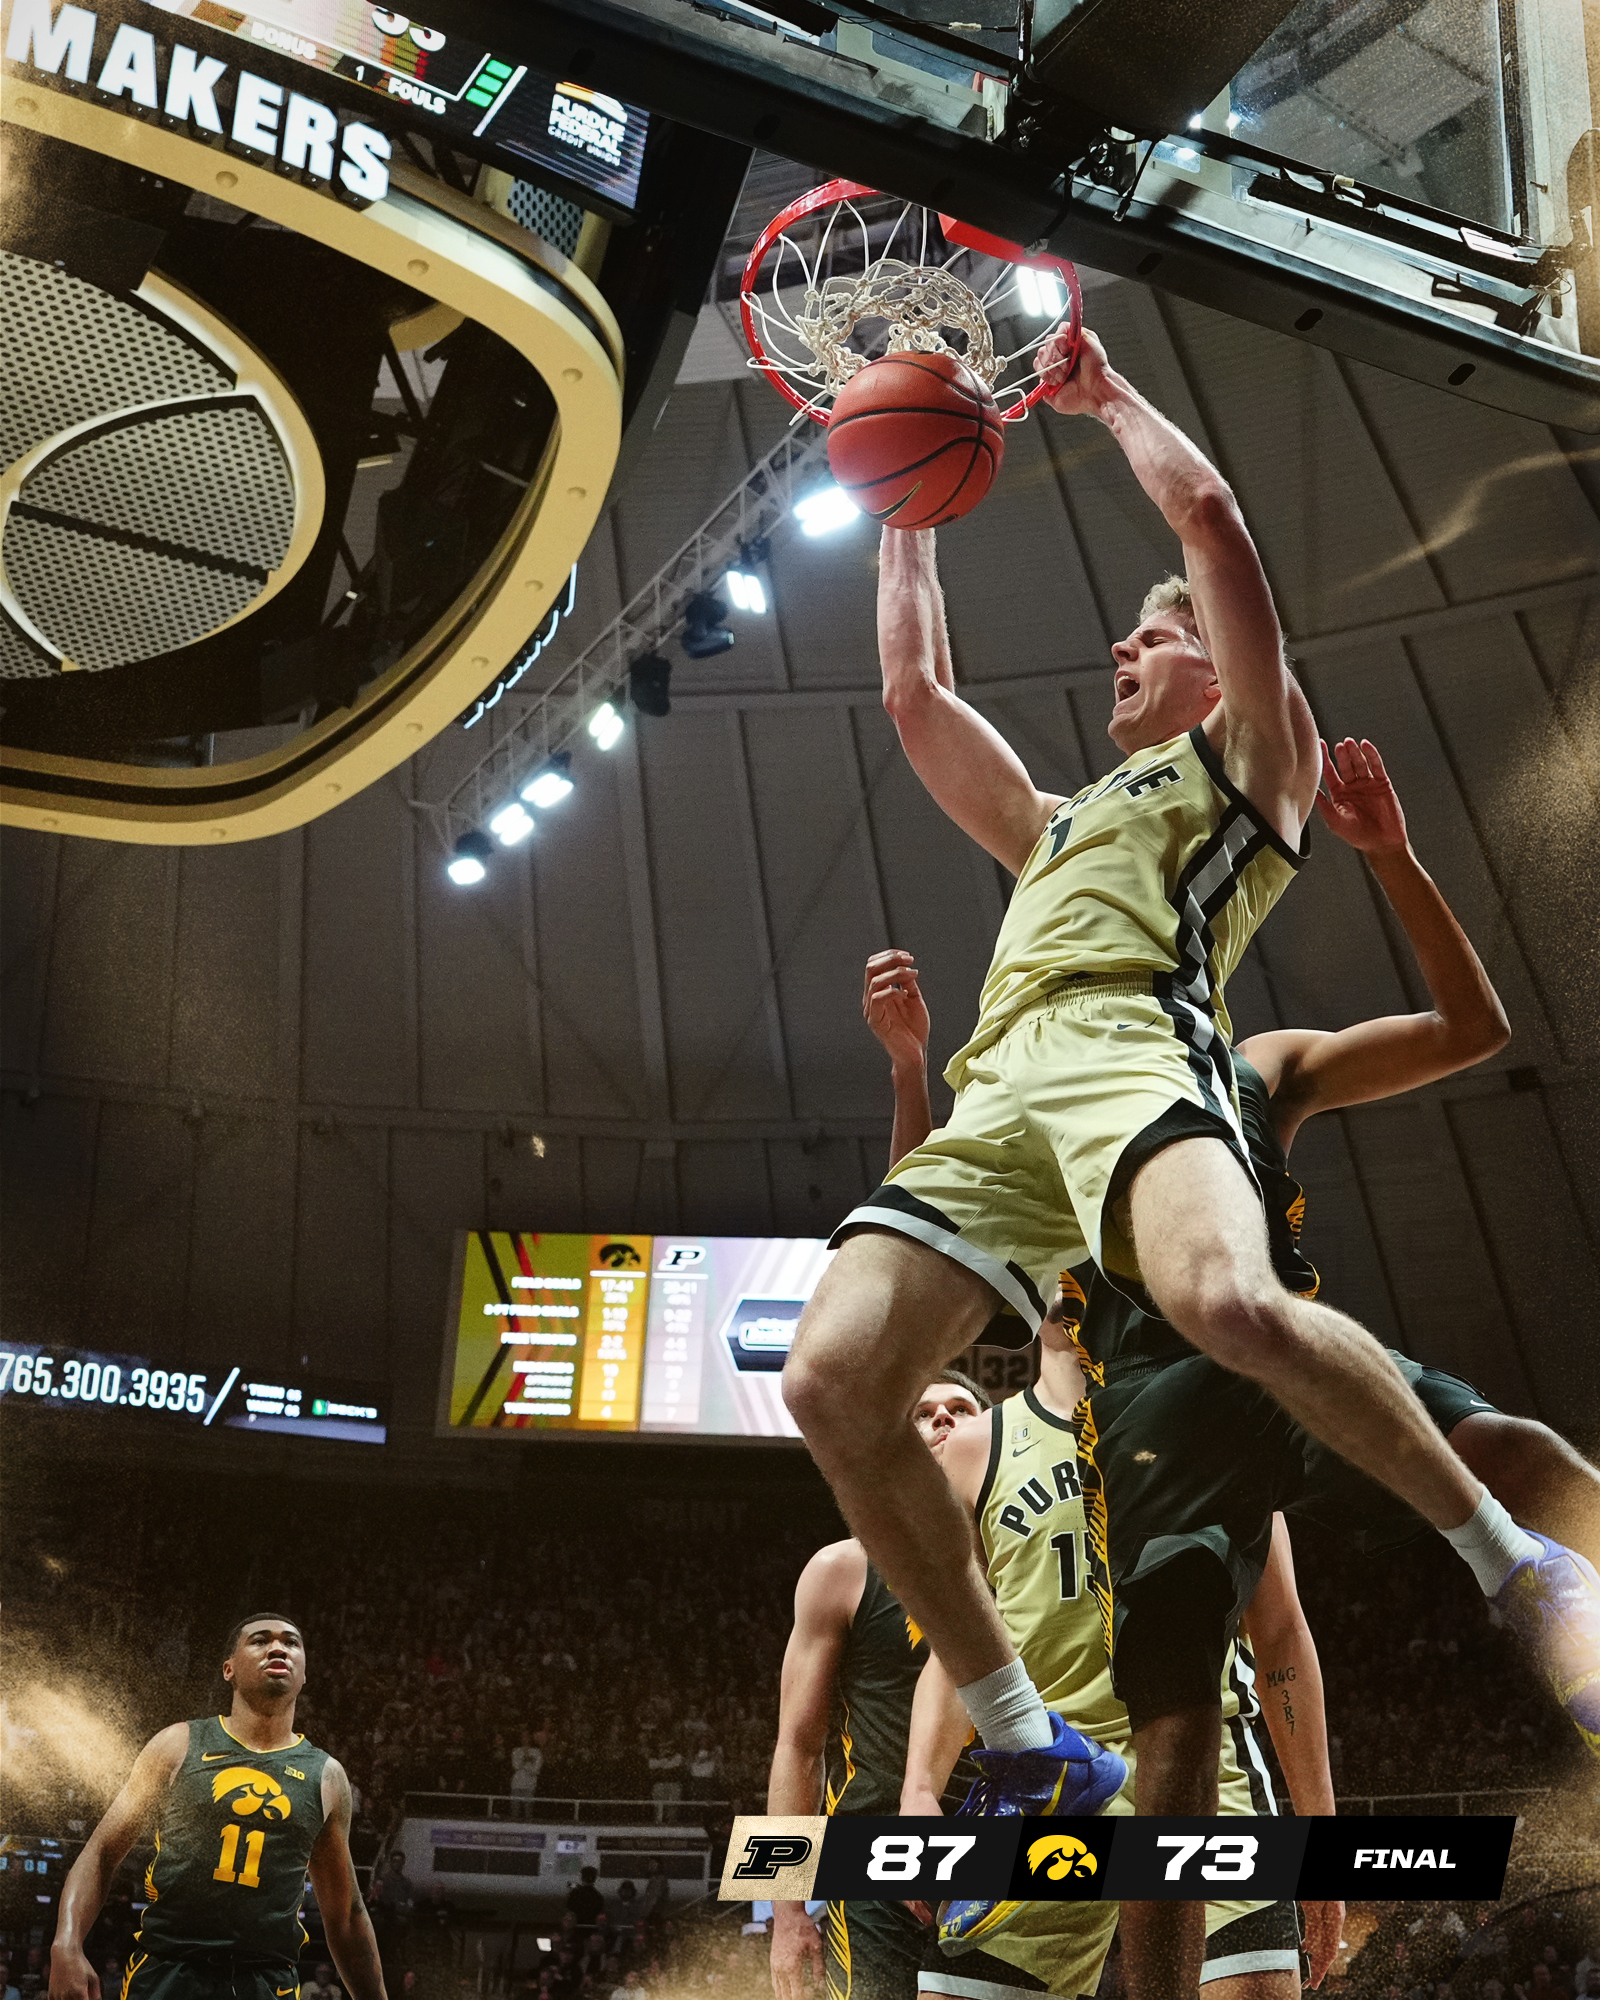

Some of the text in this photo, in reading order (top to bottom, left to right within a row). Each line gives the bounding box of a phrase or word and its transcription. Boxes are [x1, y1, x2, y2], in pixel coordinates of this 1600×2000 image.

[251, 21, 316, 60] BONUS
[5, 0, 392, 201] MAKERS
[356, 65, 447, 115] 1 FOULS
[549, 110, 622, 157] FEDERAL
[552, 93, 626, 142] PURDUE
[0, 1352, 207, 1413] 765.300.3935
[982, 1354, 1031, 1389] 32
[999, 1459, 1082, 1538] PUR
[212, 1823, 266, 1889] 11
